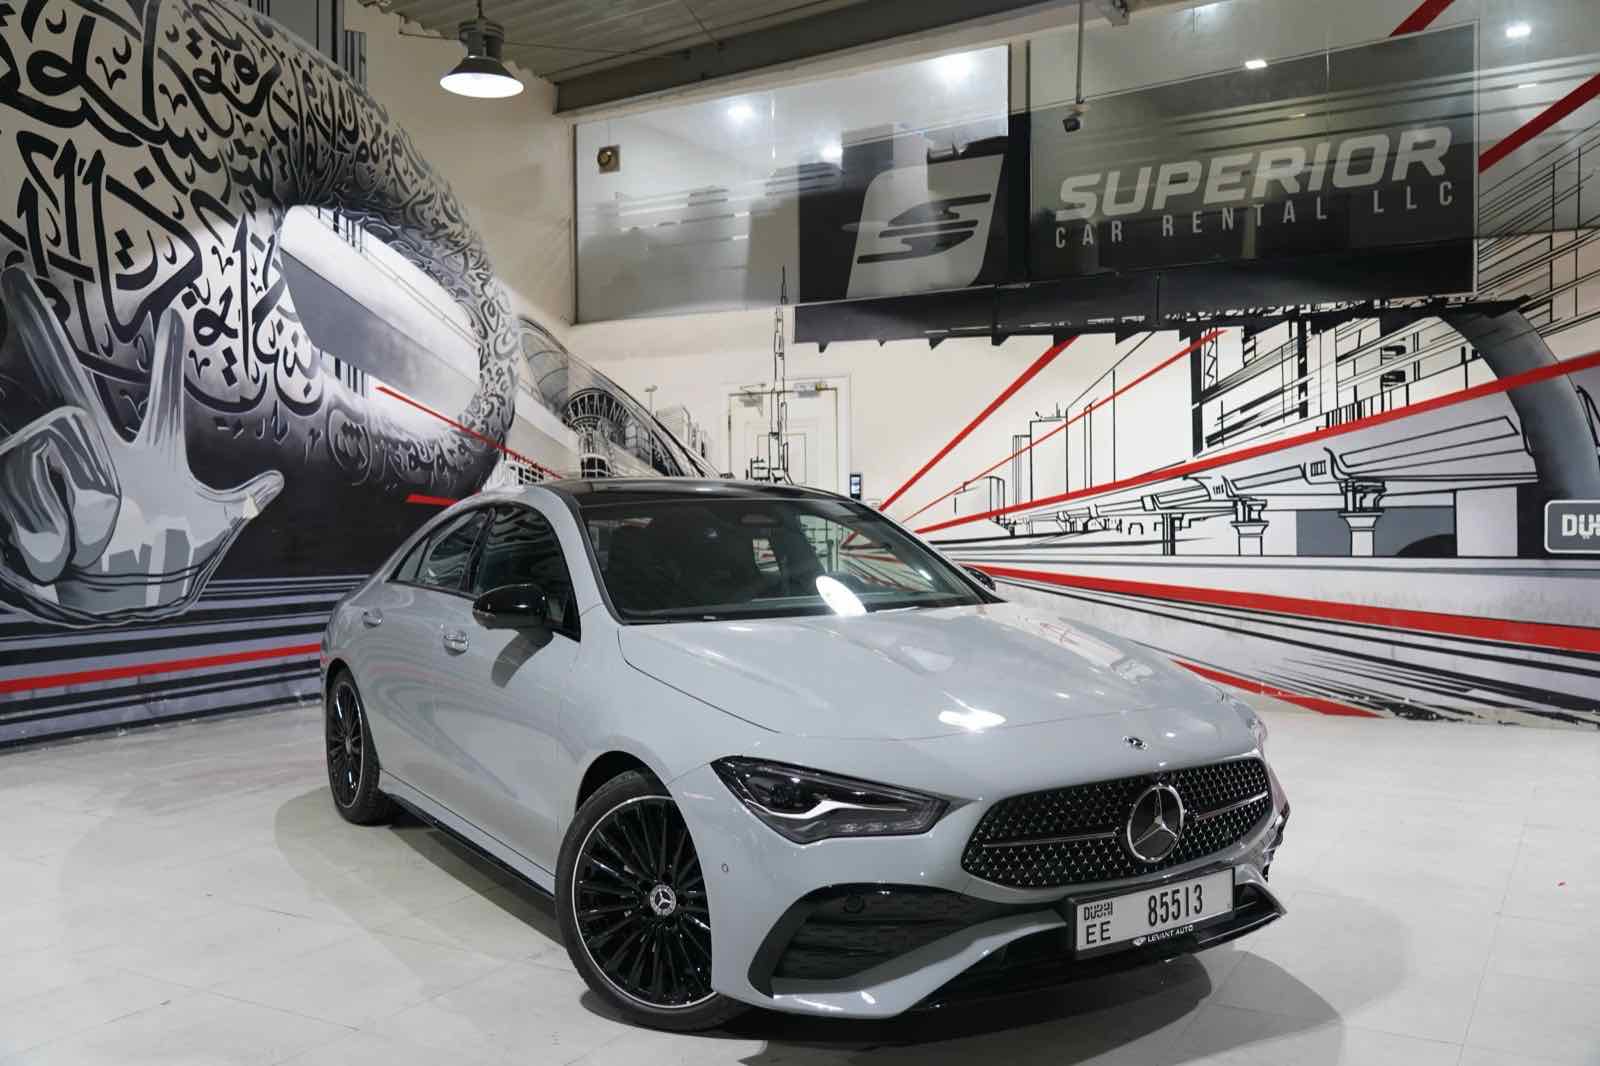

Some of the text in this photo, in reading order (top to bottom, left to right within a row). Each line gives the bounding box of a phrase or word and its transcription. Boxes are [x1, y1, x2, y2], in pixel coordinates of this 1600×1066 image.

[1055, 126, 1452, 222] SUPERIOR
[1055, 181, 1454, 249] CAR RENTAL LLC
[1148, 884, 1203, 926] 85513
[1086, 920, 1111, 945] EE
[1175, 924, 1193, 935] AUTO
